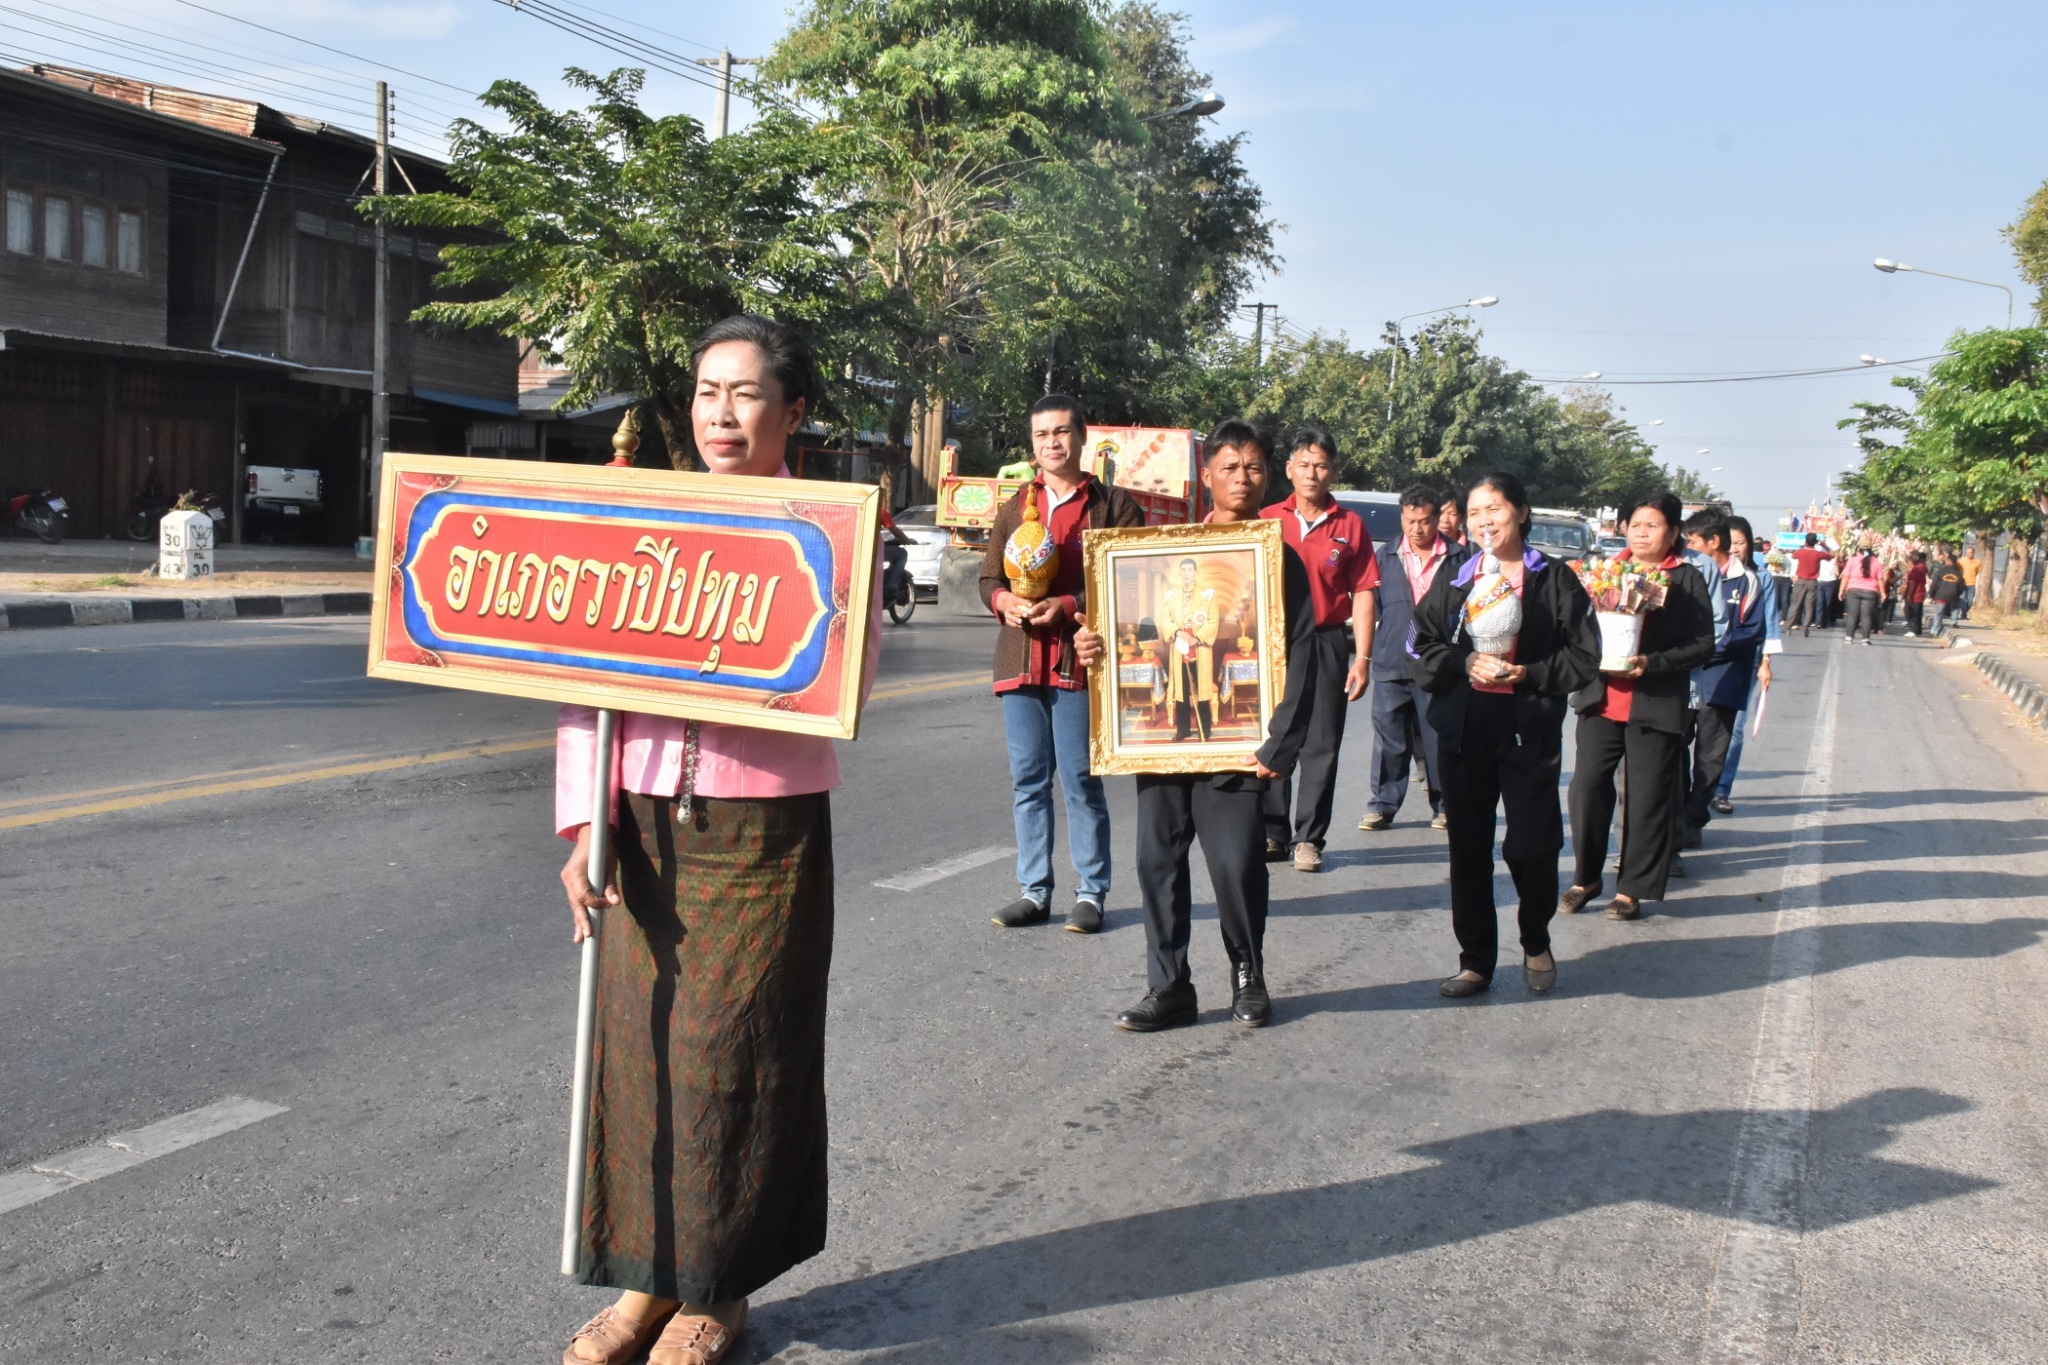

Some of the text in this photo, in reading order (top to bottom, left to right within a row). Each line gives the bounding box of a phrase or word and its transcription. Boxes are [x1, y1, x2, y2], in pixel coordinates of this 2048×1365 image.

[164, 533, 181, 547] 30
[193, 563, 210, 577] 30
[445, 515, 781, 674] อำเภอวาปีปทุม
